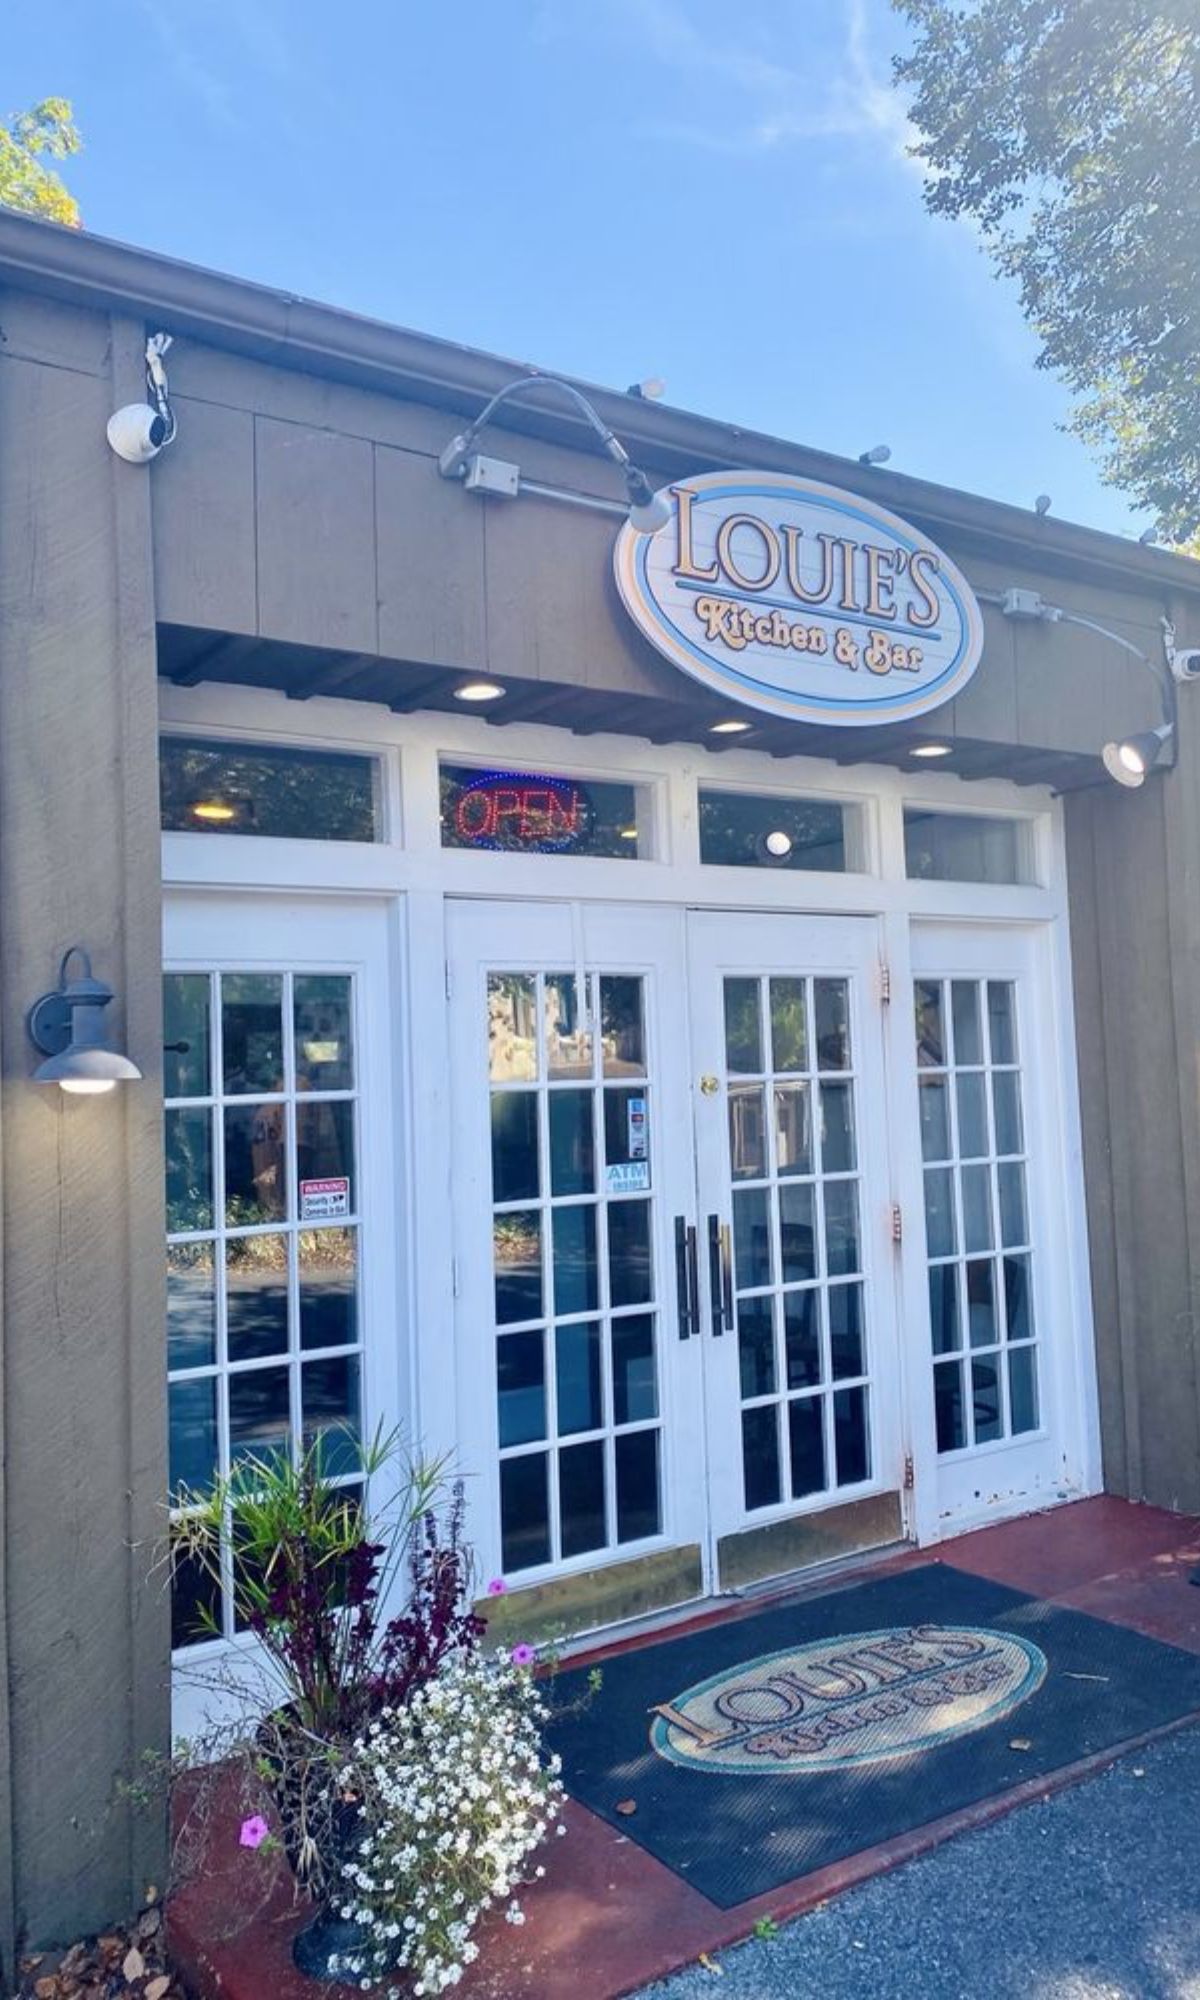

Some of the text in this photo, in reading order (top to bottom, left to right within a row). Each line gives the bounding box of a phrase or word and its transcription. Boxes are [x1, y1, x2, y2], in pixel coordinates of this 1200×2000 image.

[669, 486, 940, 628] LOUIE'S
[695, 596, 924, 676] Kitchen & Bar
[456, 789, 579, 838] OPEN
[305, 1182, 346, 1193] WARNING
[608, 1164, 646, 1180] ATM
